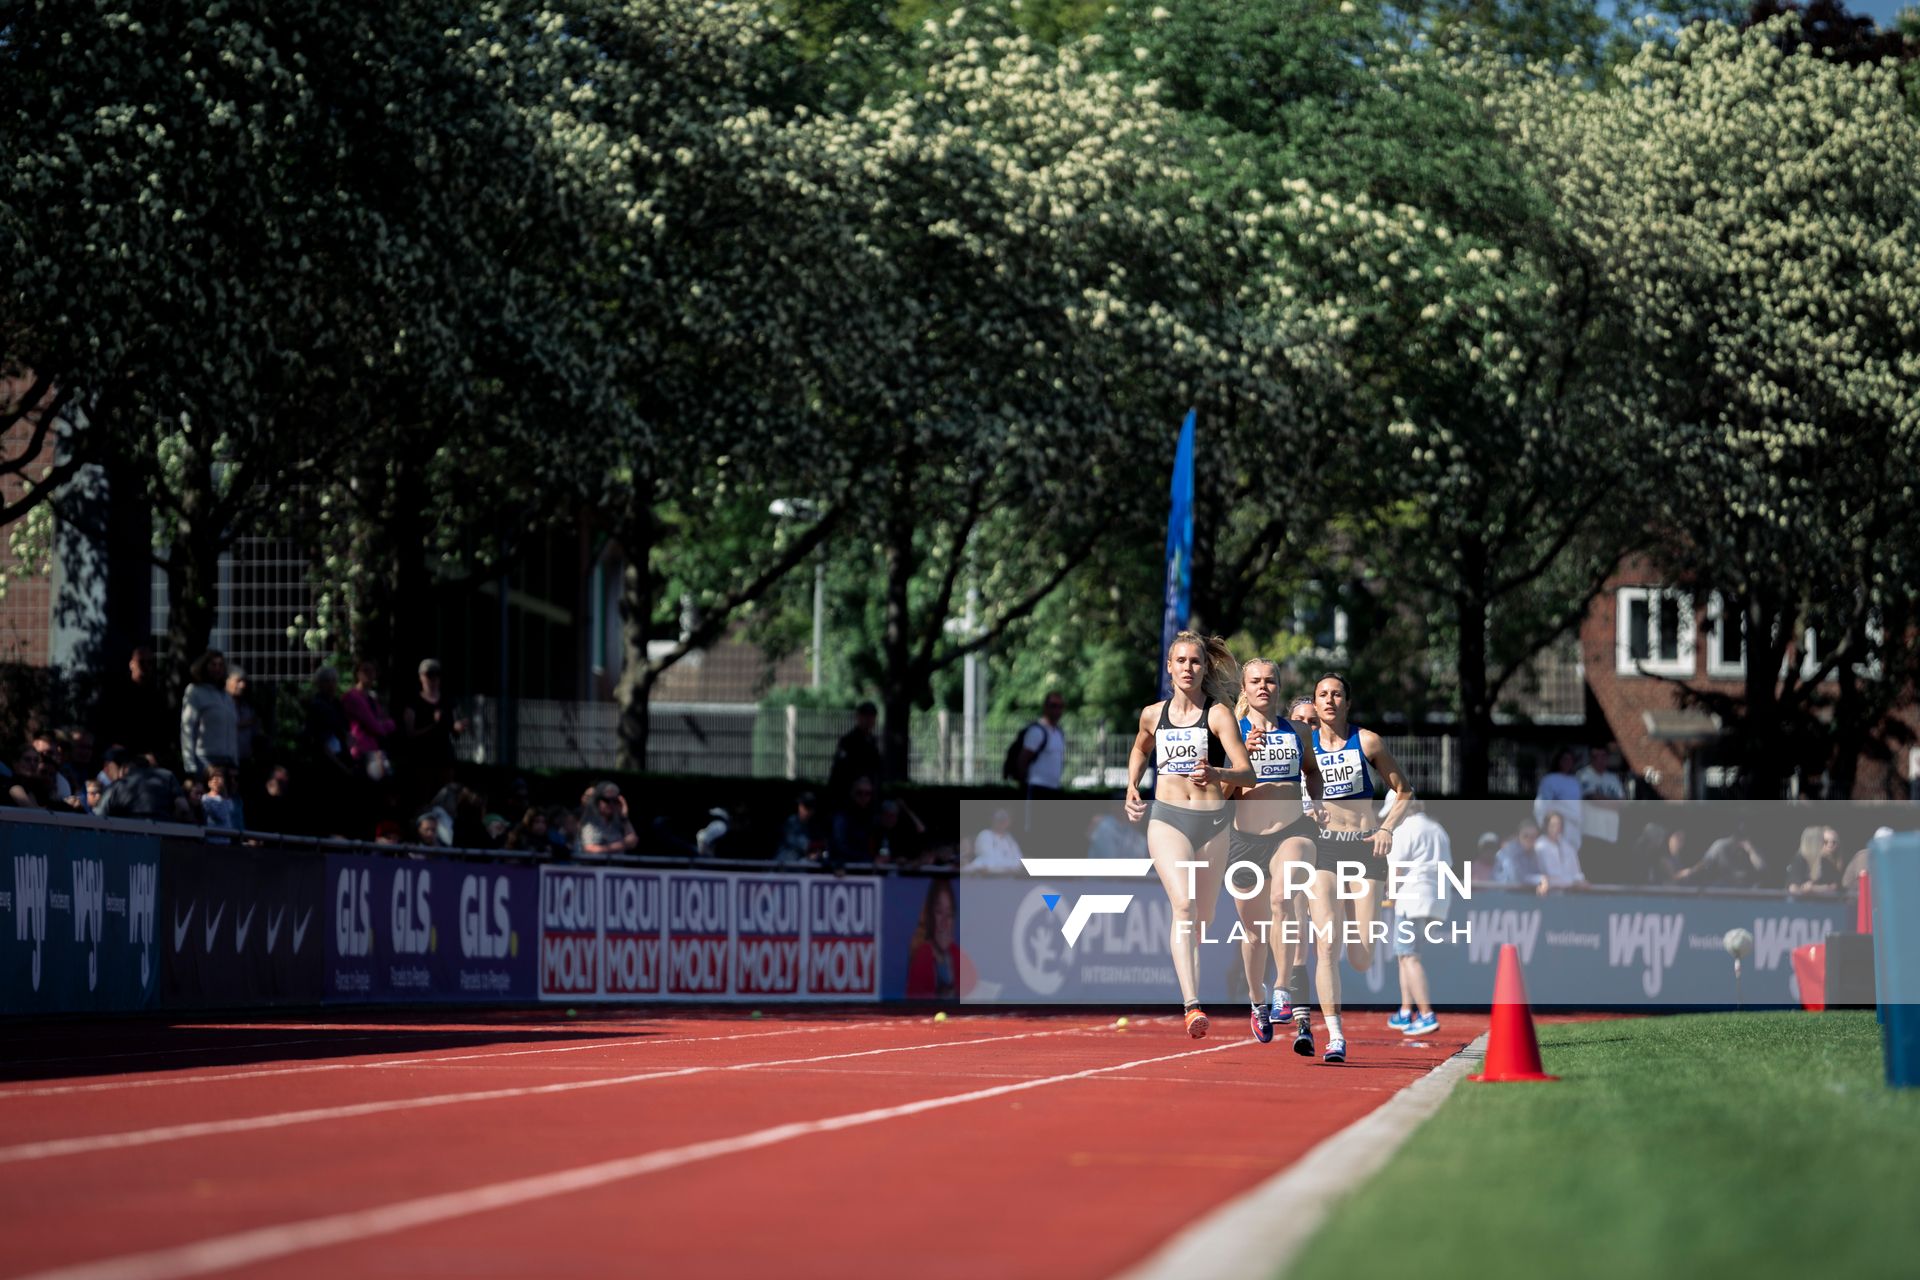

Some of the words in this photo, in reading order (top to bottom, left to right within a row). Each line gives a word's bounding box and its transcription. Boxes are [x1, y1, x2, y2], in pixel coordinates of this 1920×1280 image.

[1165, 745, 1198, 758] VOß
[1166, 730, 1192, 741] GLS
[1265, 735, 1284, 746] LS
[1269, 748, 1298, 760] BOER
[1320, 753, 1345, 766] GLS
[545, 876, 595, 931] LIQUI
[605, 878, 660, 932] LIQUI
[670, 880, 728, 933] LIQUI
[739, 883, 799, 934] LIQUI
[812, 885, 874, 935] LIQUI
[543, 936, 597, 991] MOLY
[605, 938, 660, 991] MOLY
[668, 939, 728, 991] MOLY
[738, 940, 799, 991] MOLY
[811, 941, 875, 992] MOLY
